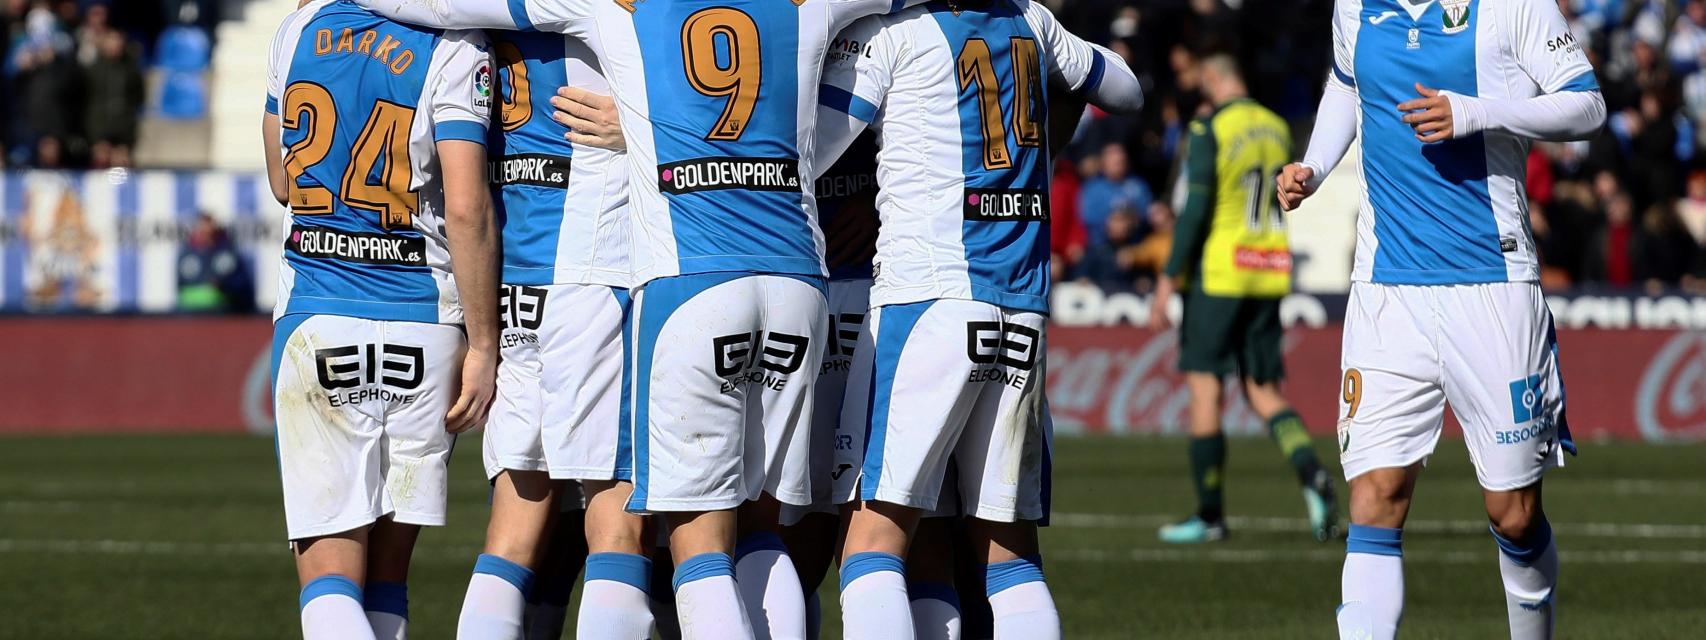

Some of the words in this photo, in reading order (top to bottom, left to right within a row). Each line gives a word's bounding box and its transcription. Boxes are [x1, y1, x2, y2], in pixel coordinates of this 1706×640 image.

[315, 28, 415, 75] DARKO
[680, 6, 762, 142] 9
[957, 36, 1040, 170] 14
[282, 80, 420, 230] 24
[673, 161, 798, 190] GOLDENPARK.es
[300, 230, 422, 263] GOLDENPARK.es
[328, 387, 415, 408] ELEPHONE
[1343, 367, 1363, 419] 9
